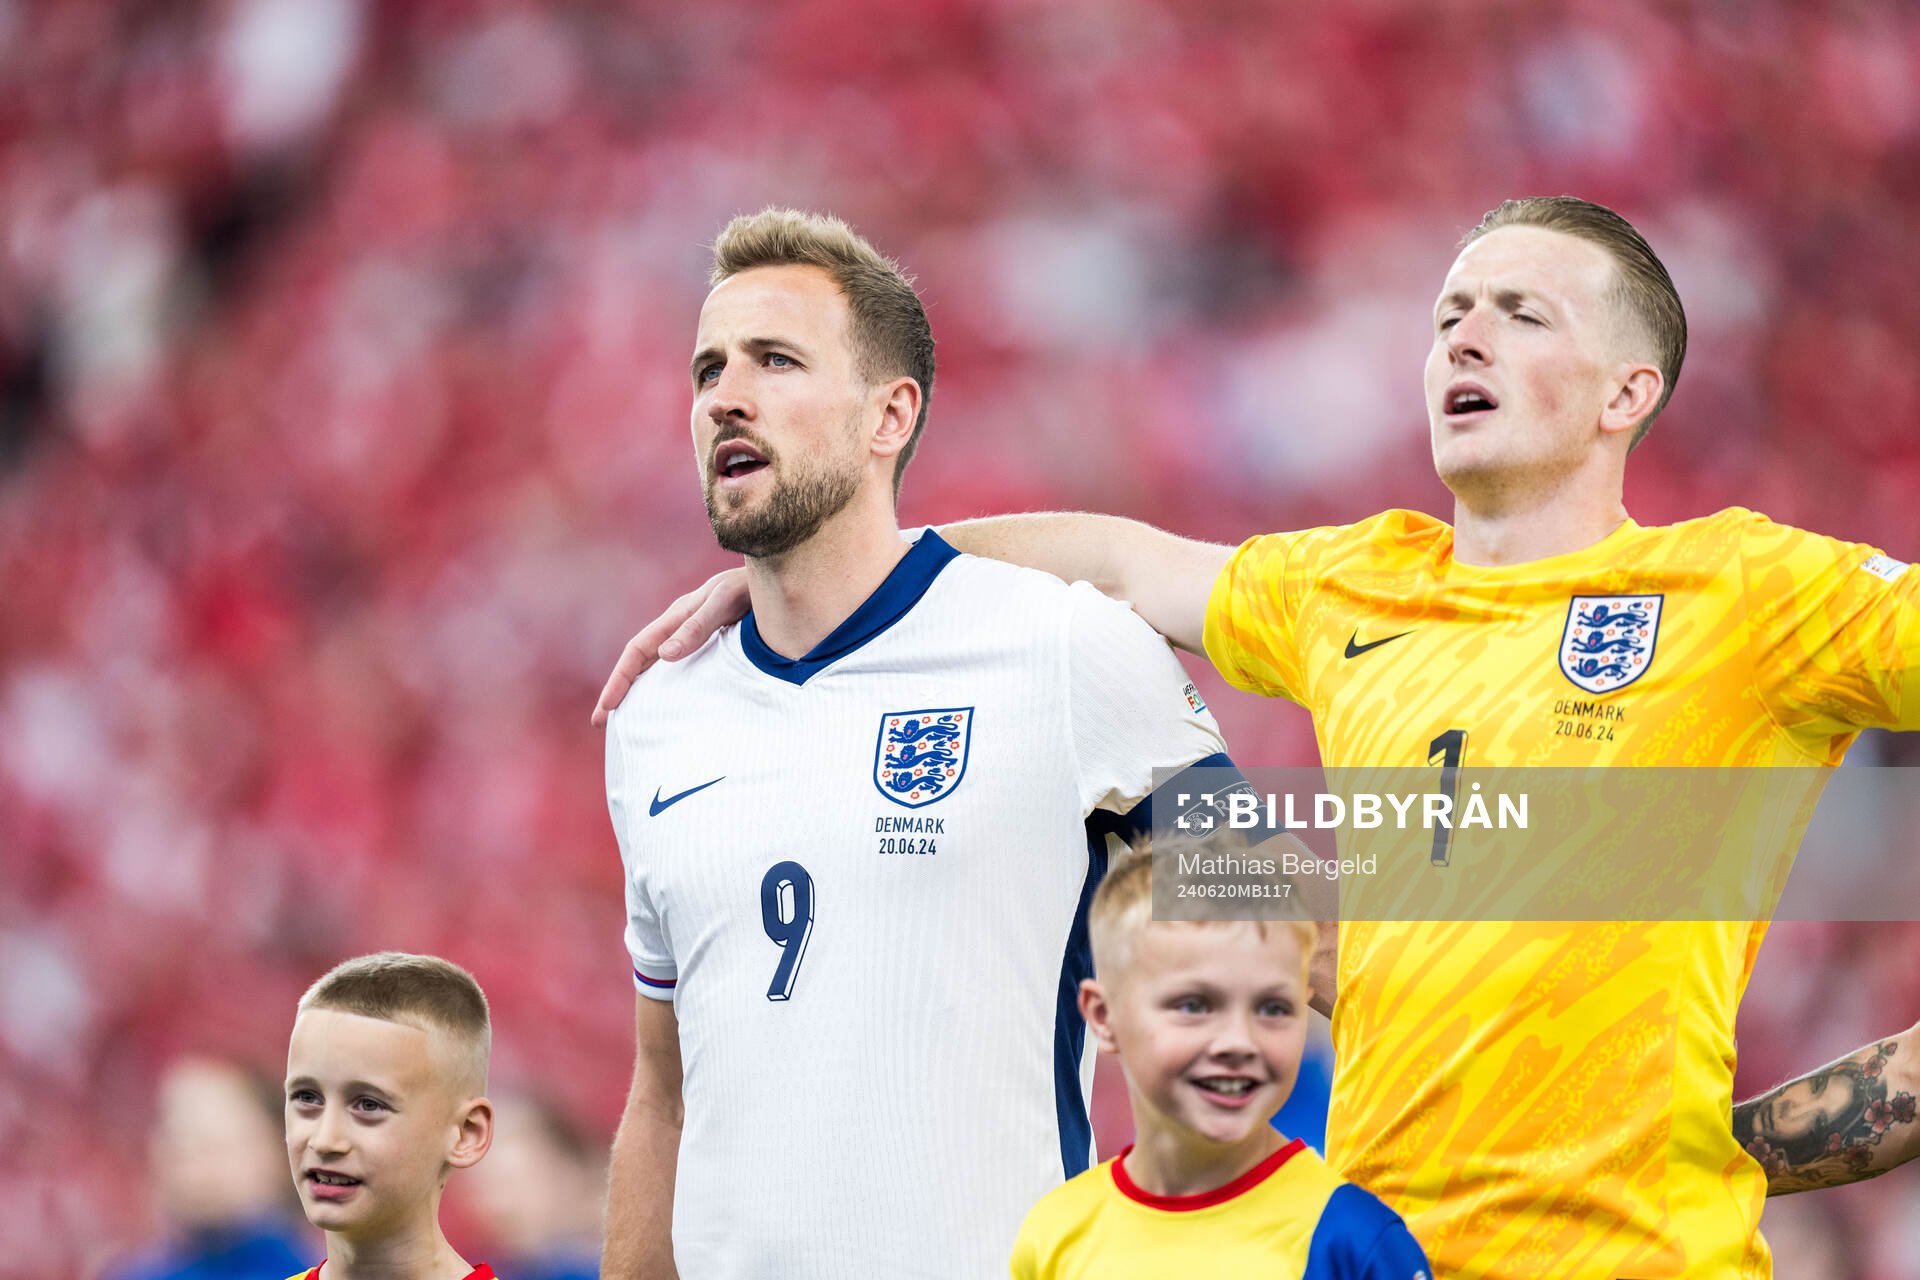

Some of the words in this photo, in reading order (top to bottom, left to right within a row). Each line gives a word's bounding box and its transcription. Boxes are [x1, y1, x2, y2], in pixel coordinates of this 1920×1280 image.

[1554, 700, 1625, 722] DENMARK
[1555, 720, 1614, 741] 20.06.24
[1428, 729, 1469, 868] 1
[875, 816, 945, 834] DENMARK
[879, 837, 937, 855] 20.06.24
[760, 860, 815, 1001] 9
